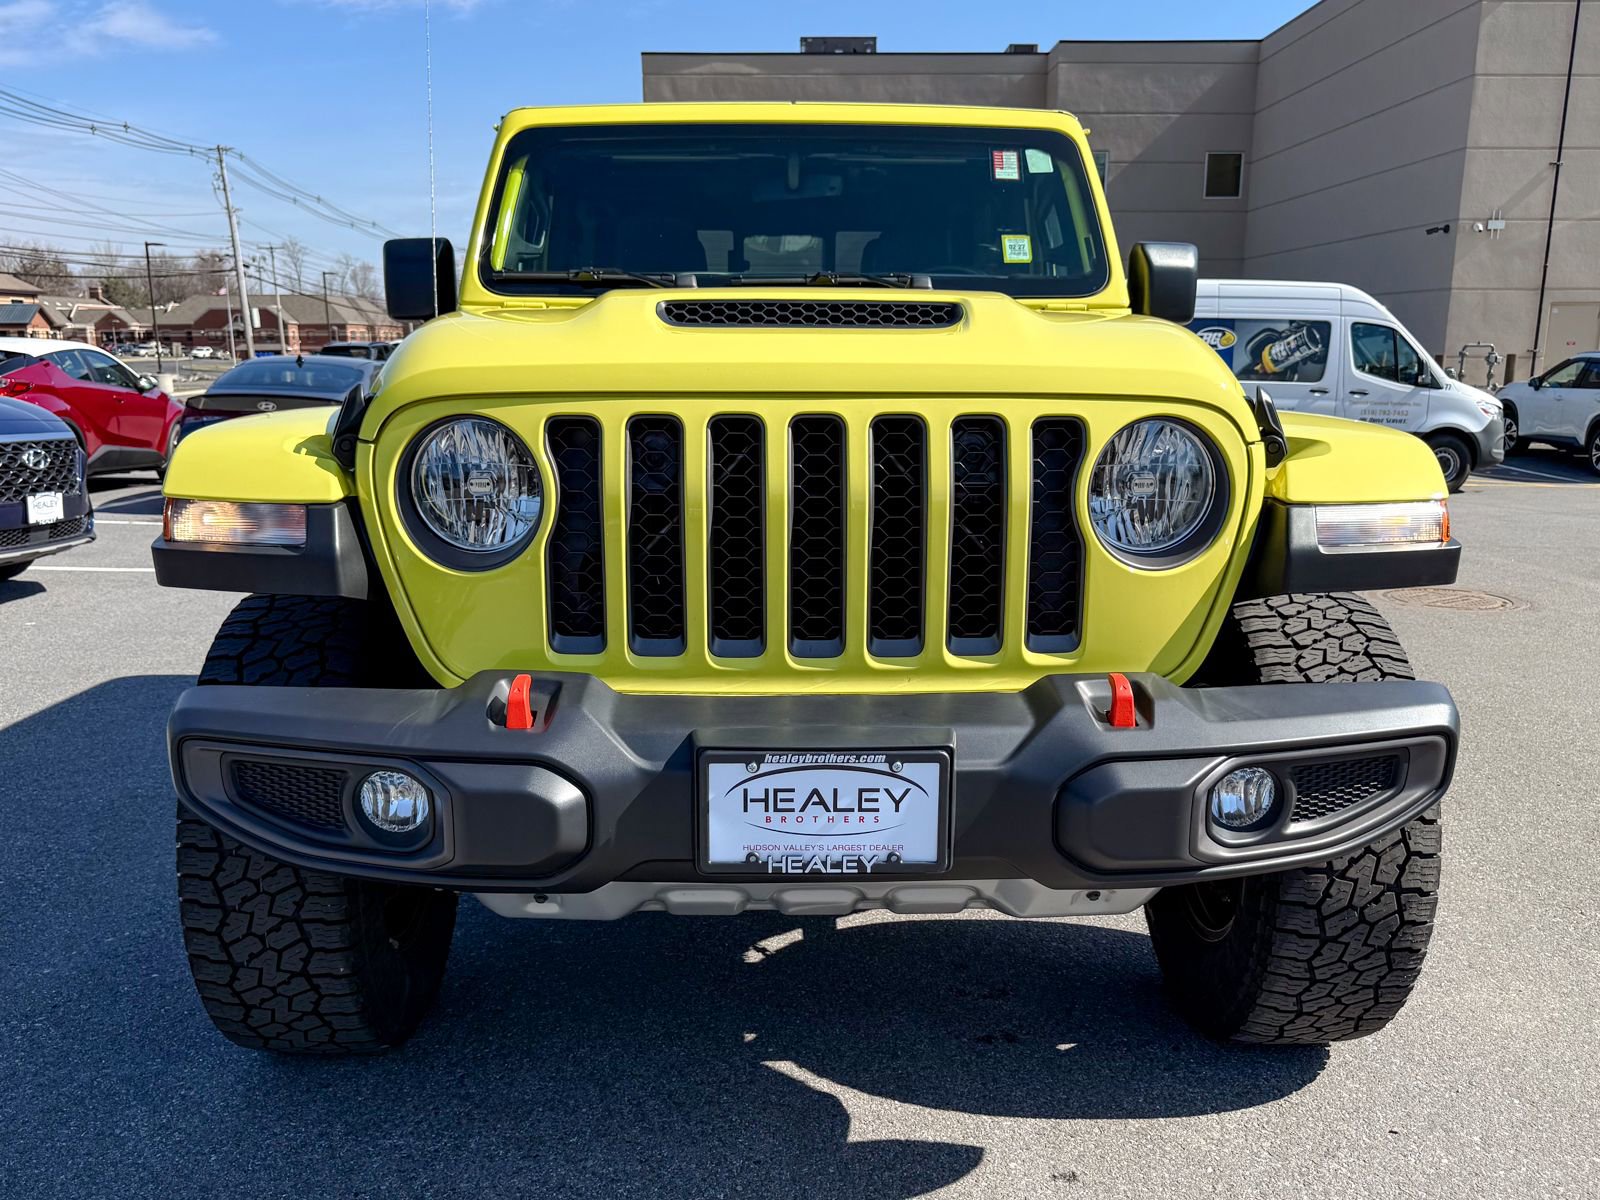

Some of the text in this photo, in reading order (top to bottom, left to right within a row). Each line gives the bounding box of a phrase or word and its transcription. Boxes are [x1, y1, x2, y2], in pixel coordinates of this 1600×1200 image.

[764, 753, 887, 764] healeybrothers.com
[743, 787, 912, 813] HEALEY
[765, 815, 880, 824] BROTHERS
[742, 844, 904, 852] HUDSON VALLEY'S LARGEST DEALER
[766, 854, 879, 874] HEALEY
